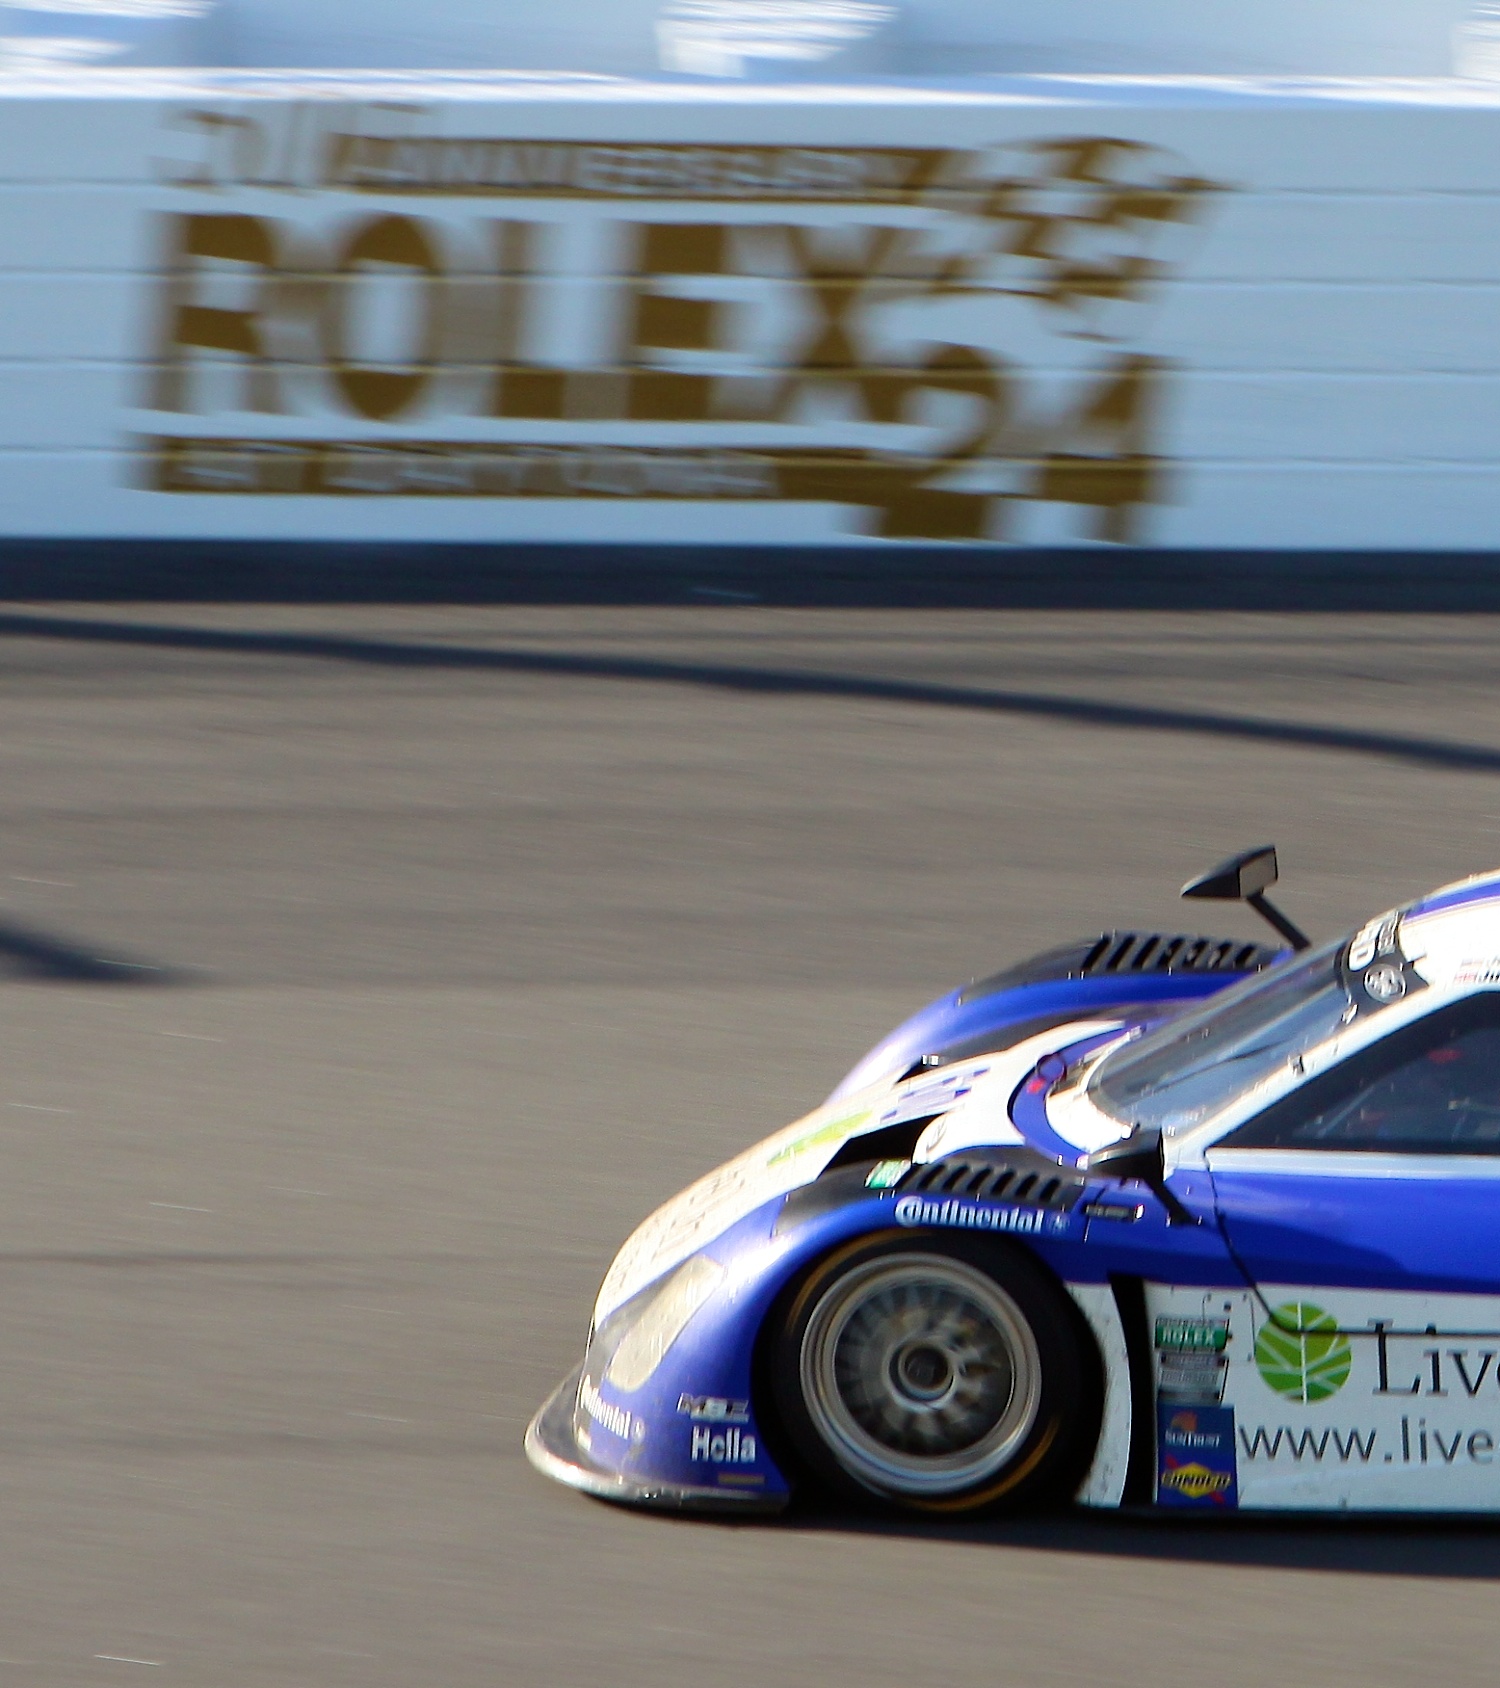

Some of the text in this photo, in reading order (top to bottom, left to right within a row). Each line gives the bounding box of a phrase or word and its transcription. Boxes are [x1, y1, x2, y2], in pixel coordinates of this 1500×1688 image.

[140, 205, 932, 427] ROLEX
[895, 1196, 1046, 1235] Continental
[691, 1425, 757, 1463] Hella
